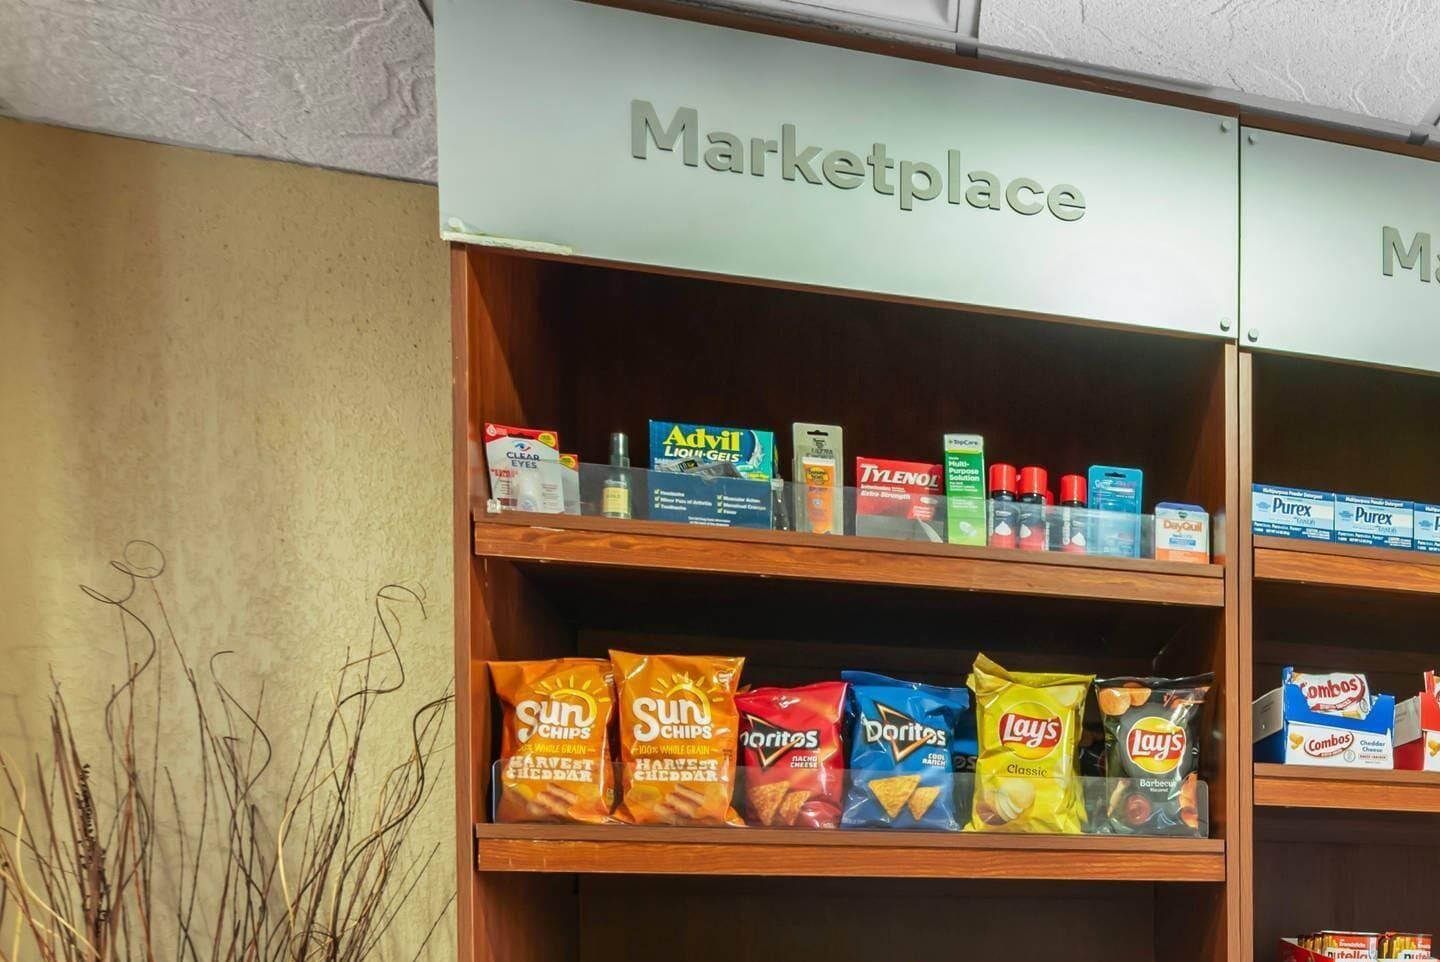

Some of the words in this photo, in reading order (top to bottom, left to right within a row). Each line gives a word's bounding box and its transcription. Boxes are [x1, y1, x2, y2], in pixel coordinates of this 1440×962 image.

[630, 99, 1087, 222] Marketplace
[662, 425, 741, 452] Advil
[953, 439, 978, 447] TopCare
[506, 451, 541, 462] CLEAR
[511, 460, 538, 469] EYES
[948, 468, 979, 476] Purpose
[860, 464, 940, 488] TYLENOL
[949, 474, 980, 482] Solution
[860, 489, 880, 498] Extra
[880, 491, 911, 500] Strength
[1272, 497, 1312, 518] Purex
[1354, 506, 1393, 526] Purex
[1163, 519, 1203, 533] DayQuil
[1301, 678, 1358, 700] ombos
[515, 700, 594, 743] Sun
[632, 697, 712, 743] Sun
[538, 724, 591, 740] CHIPS
[659, 724, 713, 740] CHIPS
[861, 719, 947, 747] Doritos
[1003, 713, 1059, 748] Lay's
[535, 743, 561, 753] WHOLE
[561, 744, 586, 754] GRAIN
[661, 744, 685, 755] WHOLE
[686, 744, 710, 755] GRAIN
[1132, 730, 1184, 760] Lay's
[1308, 733, 1351, 752] Combos
[509, 755, 595, 770] HARVEST
[635, 757, 719, 771] HARVEST
[1006, 763, 1048, 777] Classic
[506, 767, 593, 782] CHEDDAR
[634, 768, 719, 782] CHEDDAR
[1139, 778, 1178, 788] Barbecue
